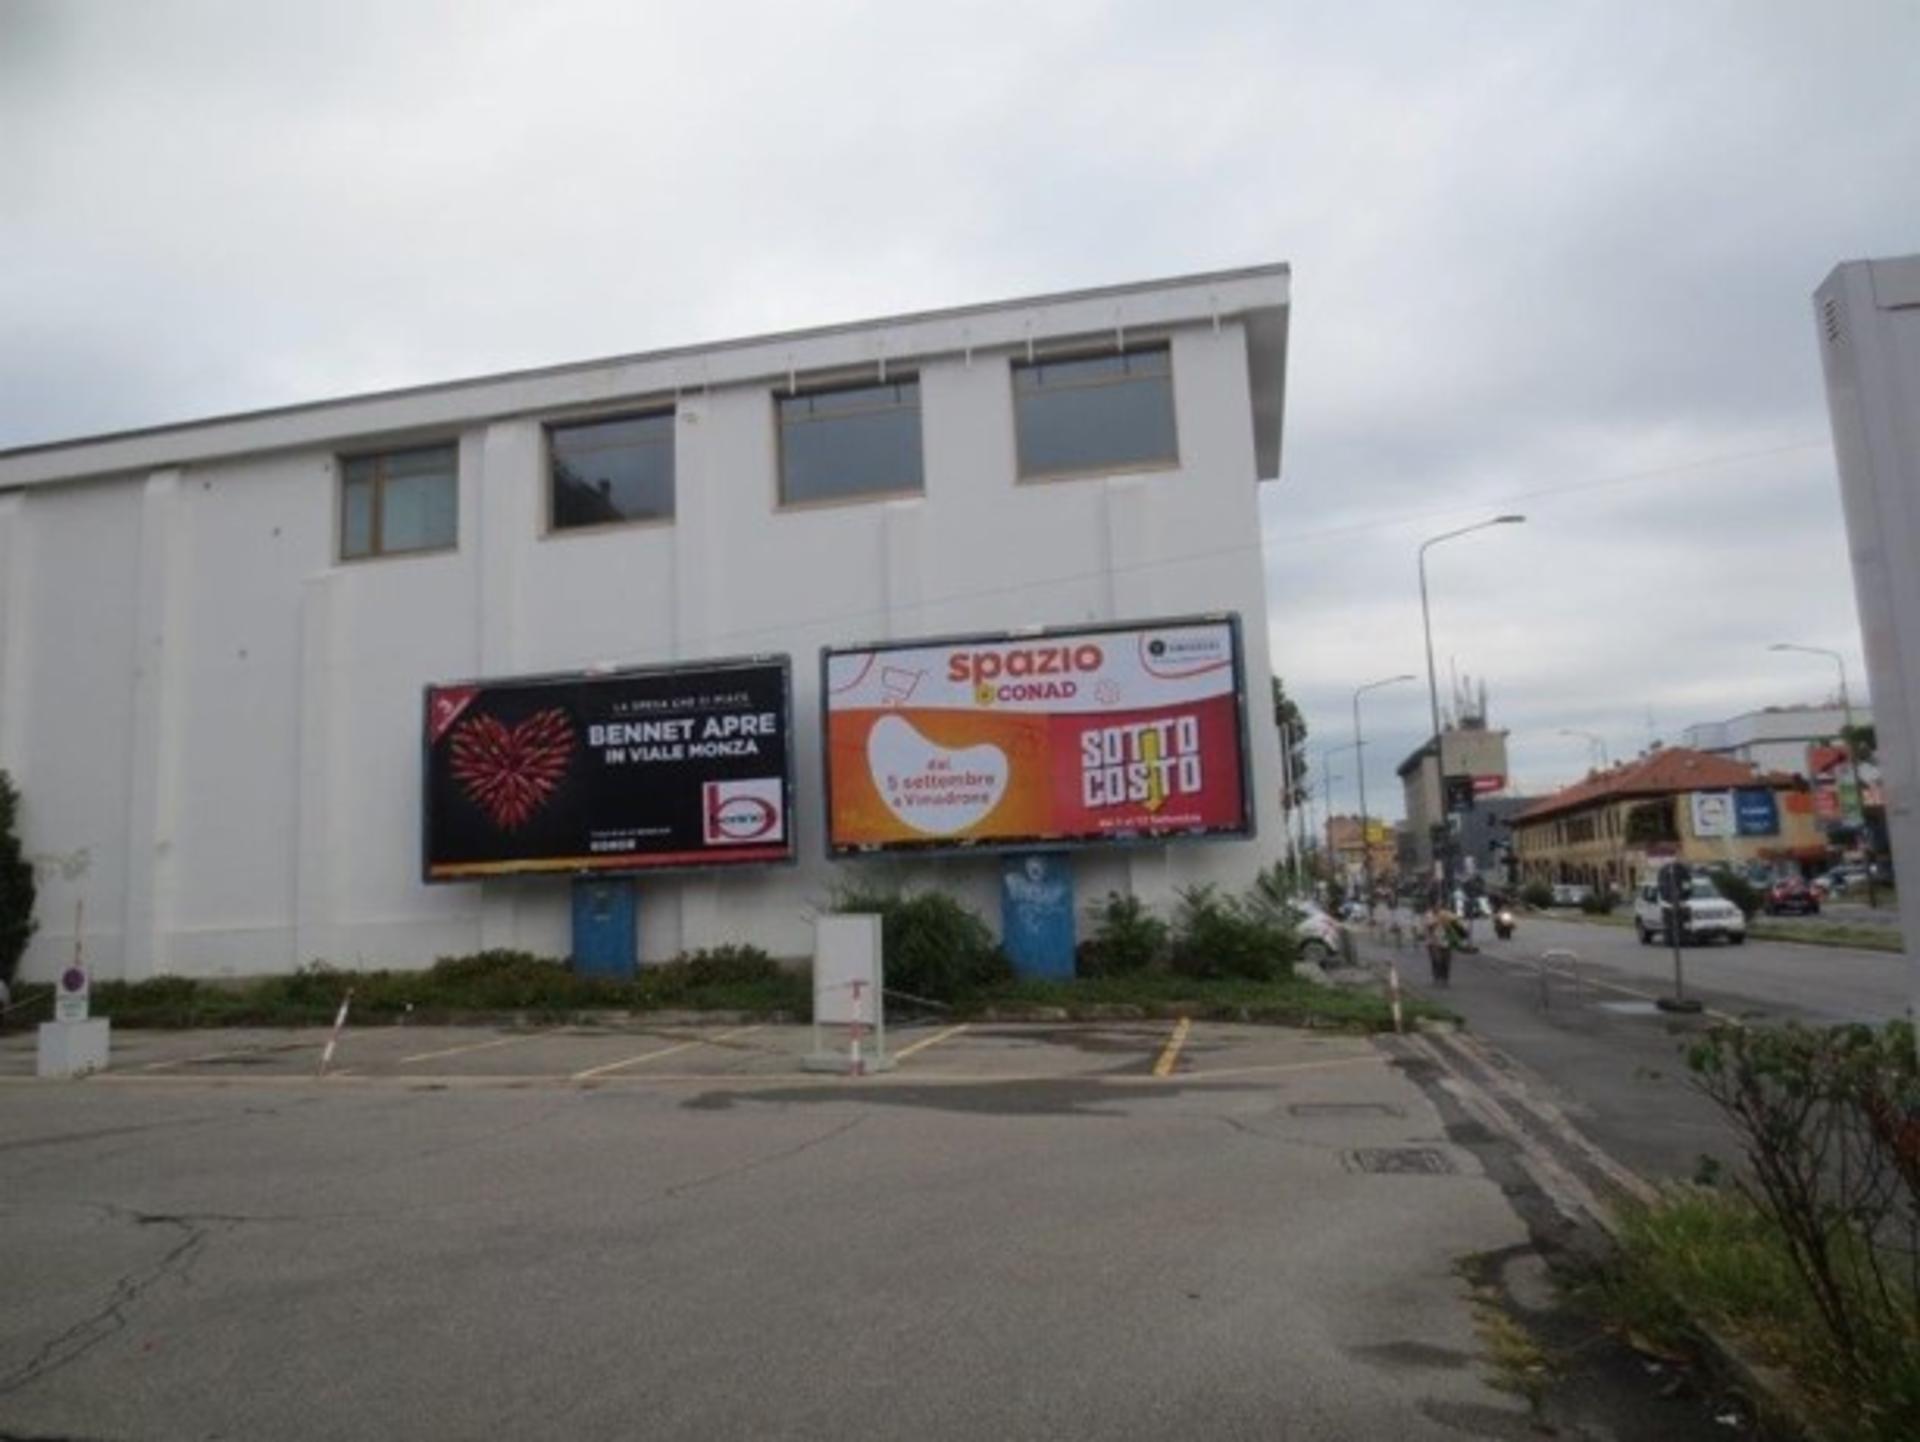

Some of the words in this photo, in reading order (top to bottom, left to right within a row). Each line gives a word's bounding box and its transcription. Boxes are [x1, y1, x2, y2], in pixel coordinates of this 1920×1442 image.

[947, 644, 1104, 686] spazio
[997, 681, 1077, 701] CONAD
[588, 718, 696, 747] BENNET
[702, 712, 777, 739] APRE
[1081, 715, 1199, 768] SOTTO
[605, 749, 626, 764] IN
[629, 744, 685, 763] VIALE
[688, 739, 759, 759] MONZA
[1083, 755, 1202, 808] COSTO
